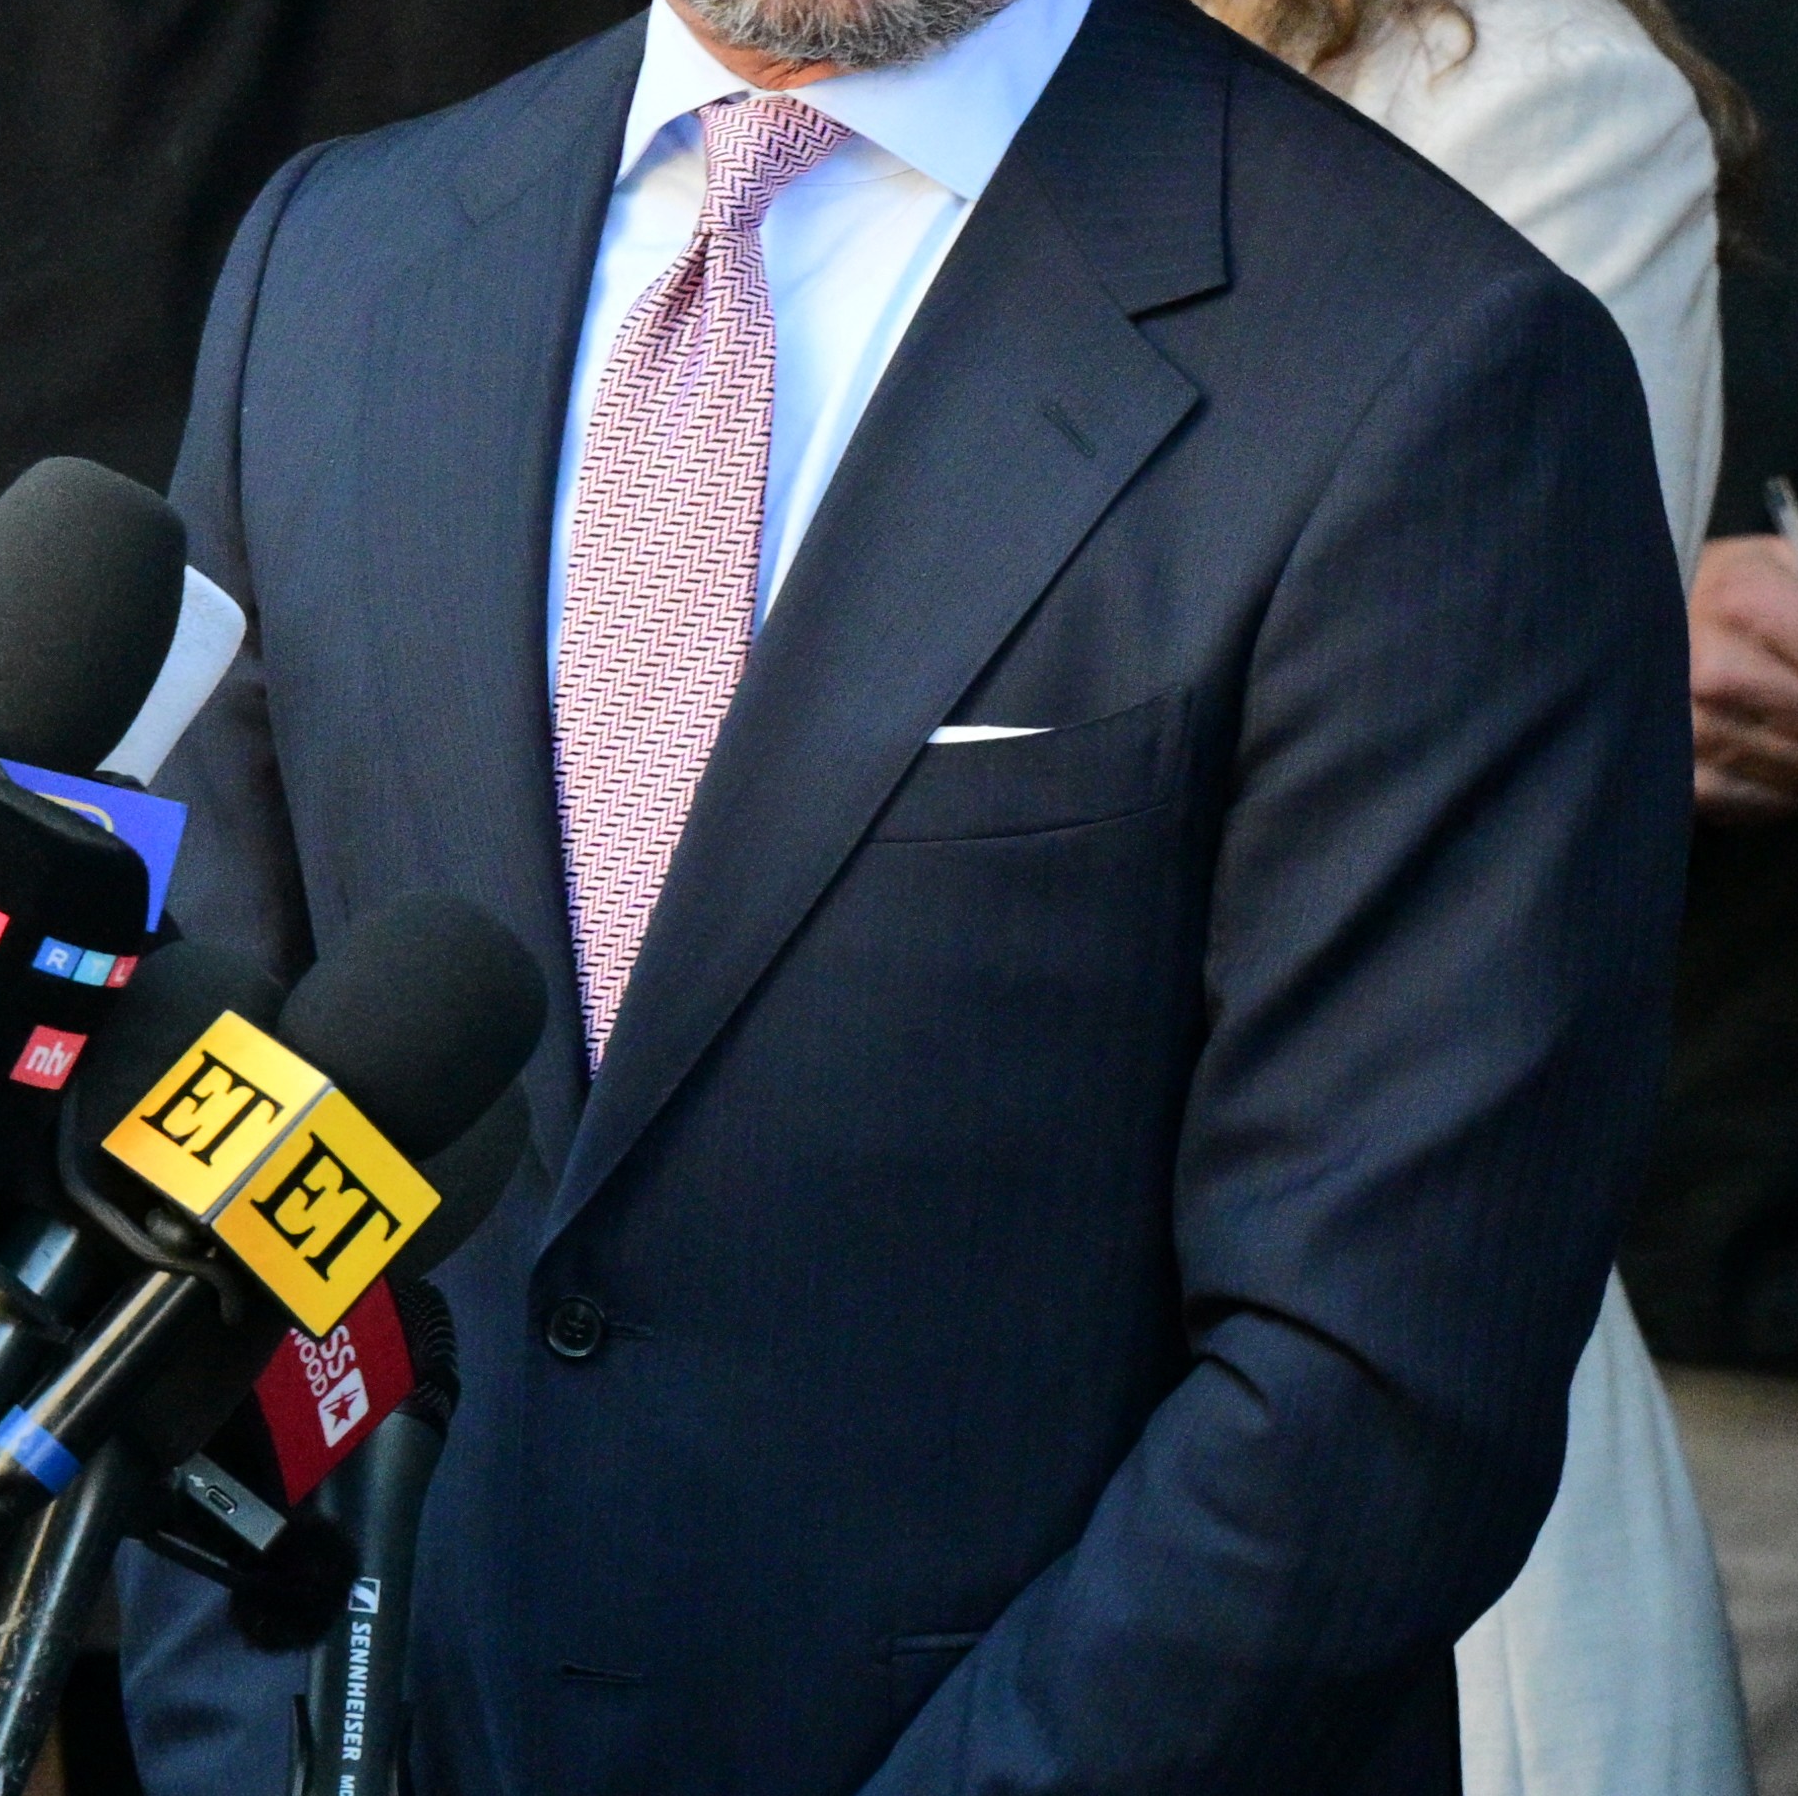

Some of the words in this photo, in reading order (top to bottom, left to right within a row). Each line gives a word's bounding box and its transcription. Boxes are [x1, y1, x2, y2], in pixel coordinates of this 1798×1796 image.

[45, 946, 130, 984] RTL
[27, 1042, 78, 1077] ntv
[141, 1050, 282, 1167] ET
[250, 1131, 402, 1282] ET
[342, 1621, 372, 1761] SENNHEISER
